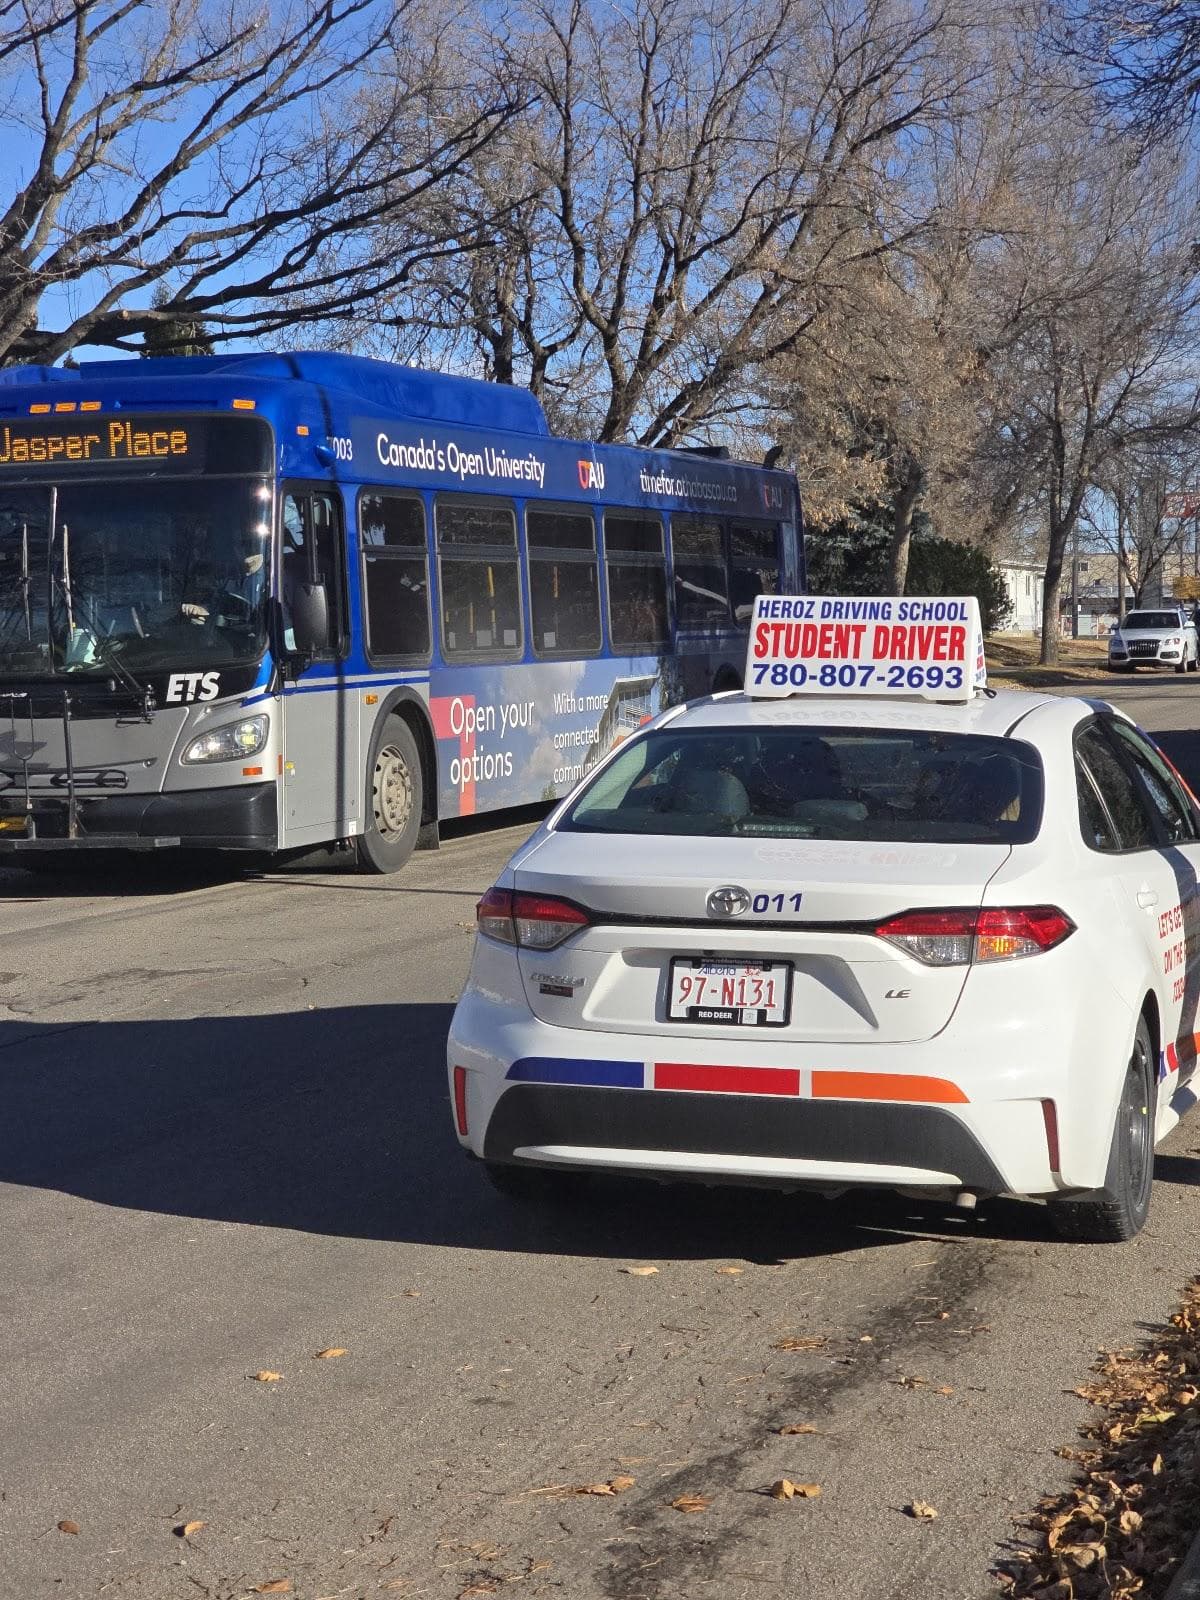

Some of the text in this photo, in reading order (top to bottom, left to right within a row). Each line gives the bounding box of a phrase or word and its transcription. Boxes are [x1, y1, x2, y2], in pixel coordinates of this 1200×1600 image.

[0, 421, 188, 462] Jasper Place
[377, 433, 545, 488] Canada's Open University
[757, 600, 969, 621] HEROZ DRIVING SCHOOL
[754, 622, 867, 659] STUDENT
[872, 625, 966, 661] DRIVER
[166, 671, 221, 702] ETS
[752, 663, 963, 689] 780-807-2693
[553, 691, 609, 714] With a more
[450, 697, 535, 743] Open your
[553, 722, 599, 750] connected
[450, 745, 513, 792] options
[752, 893, 803, 914] 011
[679, 976, 776, 1008] 97-N131
[885, 989, 911, 999] LE
[698, 1010, 733, 1020] RED DEER
